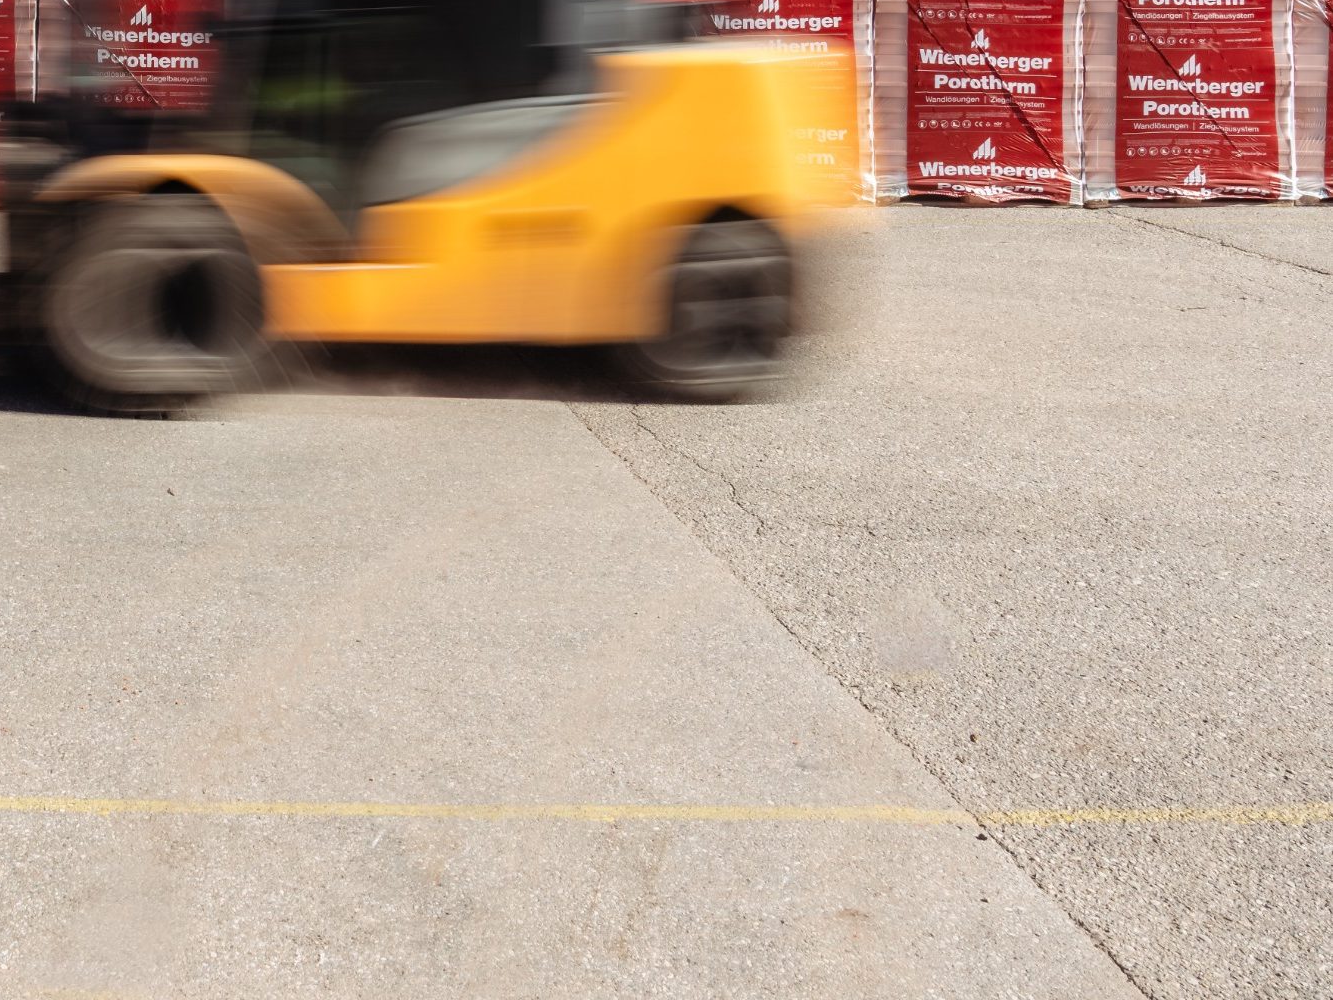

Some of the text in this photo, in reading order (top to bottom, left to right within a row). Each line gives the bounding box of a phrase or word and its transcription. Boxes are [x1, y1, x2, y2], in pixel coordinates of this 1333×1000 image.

[925, 96, 980, 104] Wandlösungen
[1133, 122, 1189, 130] Wandlösungen
[920, 162, 1057, 179] Wienerberger
